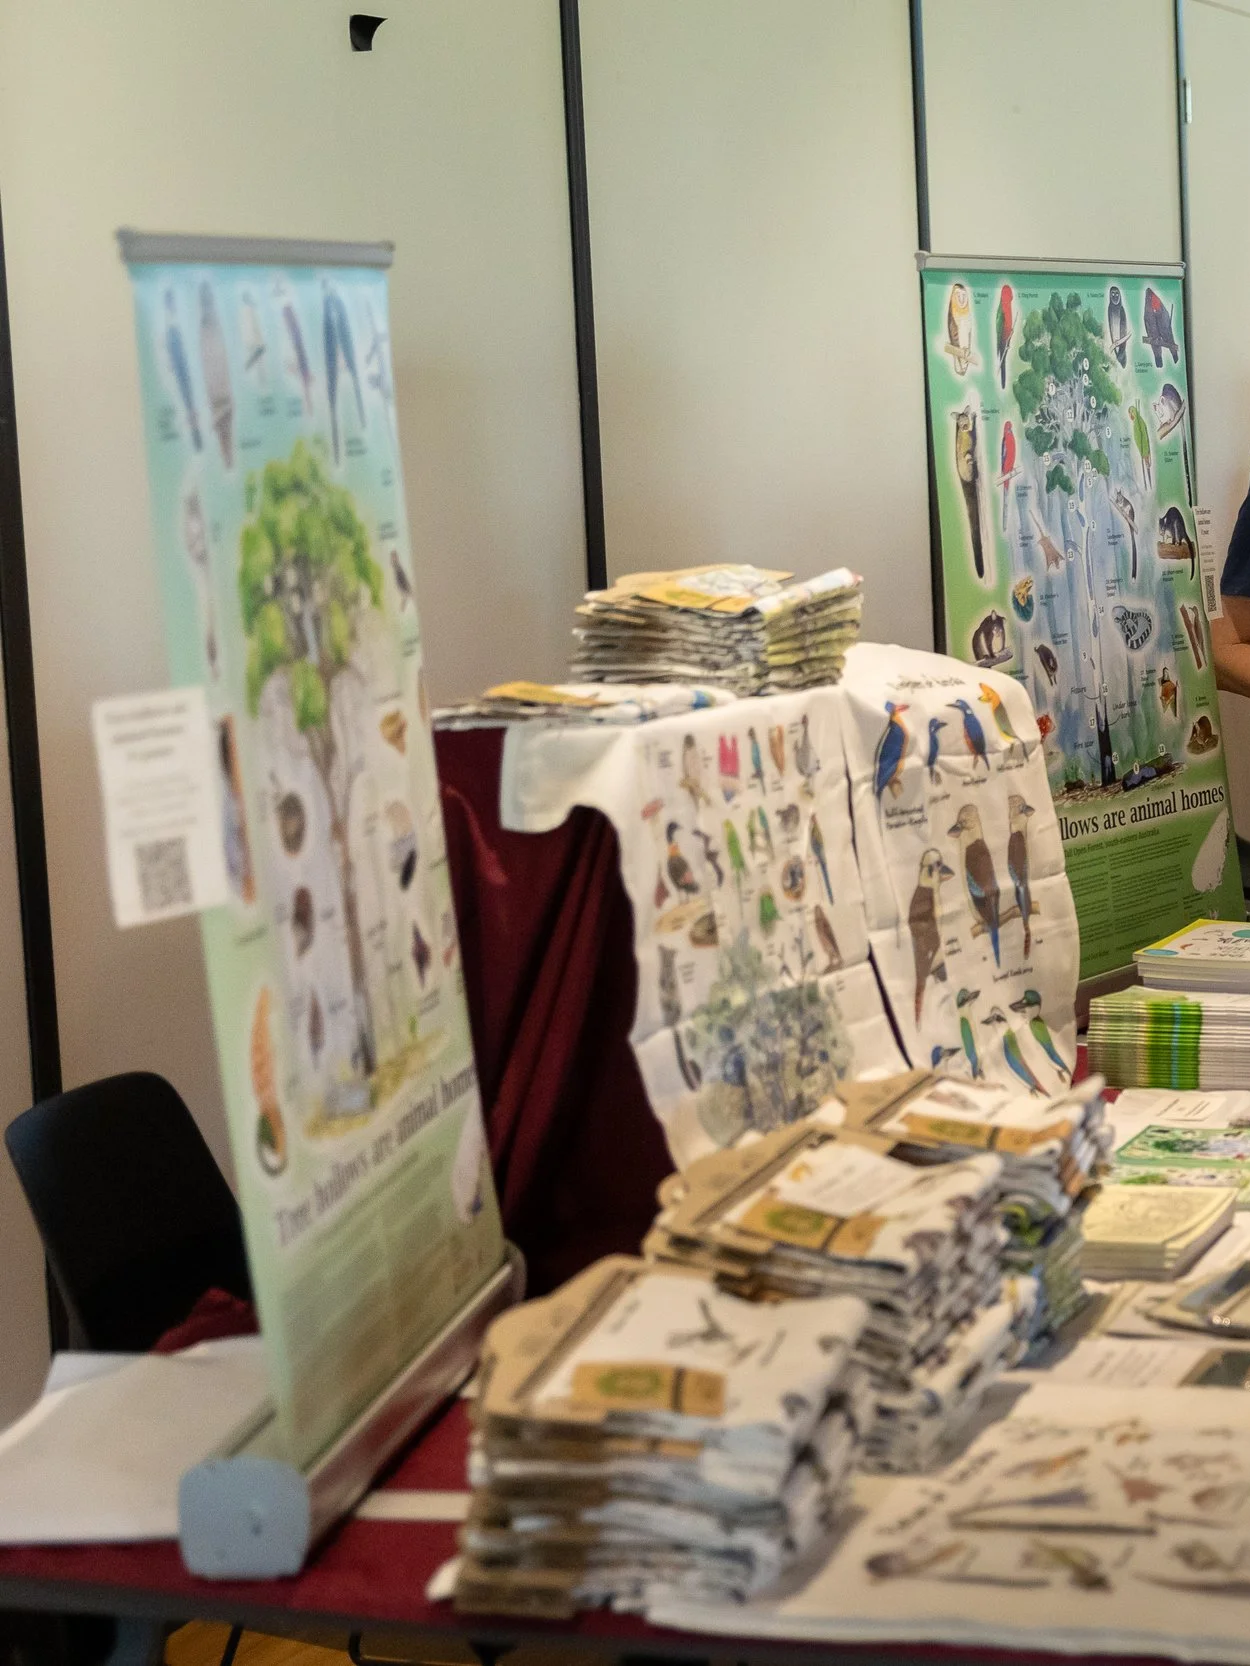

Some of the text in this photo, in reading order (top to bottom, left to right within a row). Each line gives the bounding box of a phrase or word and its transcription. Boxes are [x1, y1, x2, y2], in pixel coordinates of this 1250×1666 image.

[1103, 808, 1127, 831] are
[1130, 791, 1178, 824] animal
[1181, 785, 1225, 812] homes
